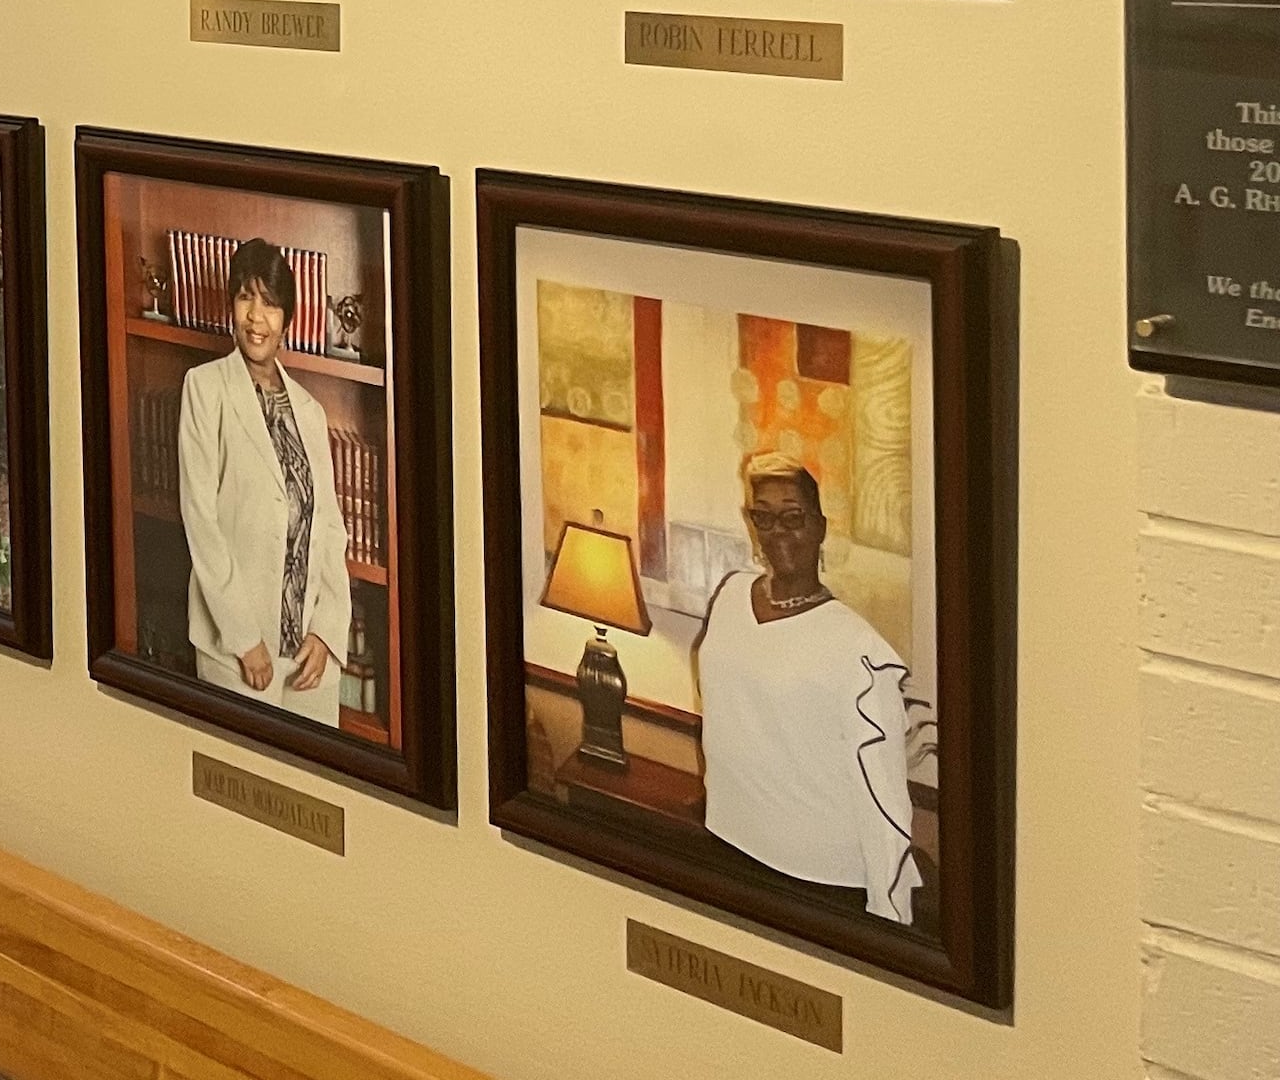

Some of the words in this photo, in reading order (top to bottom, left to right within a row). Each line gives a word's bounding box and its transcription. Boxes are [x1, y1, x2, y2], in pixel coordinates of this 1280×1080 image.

[200, 8, 252, 34] RANDY
[261, 12, 326, 39] BREWER
[640, 22, 704, 52] ROBIN
[1206, 128, 1275, 154] those
[1209, 186, 1236, 209] G.
[1206, 275, 1242, 297] We
